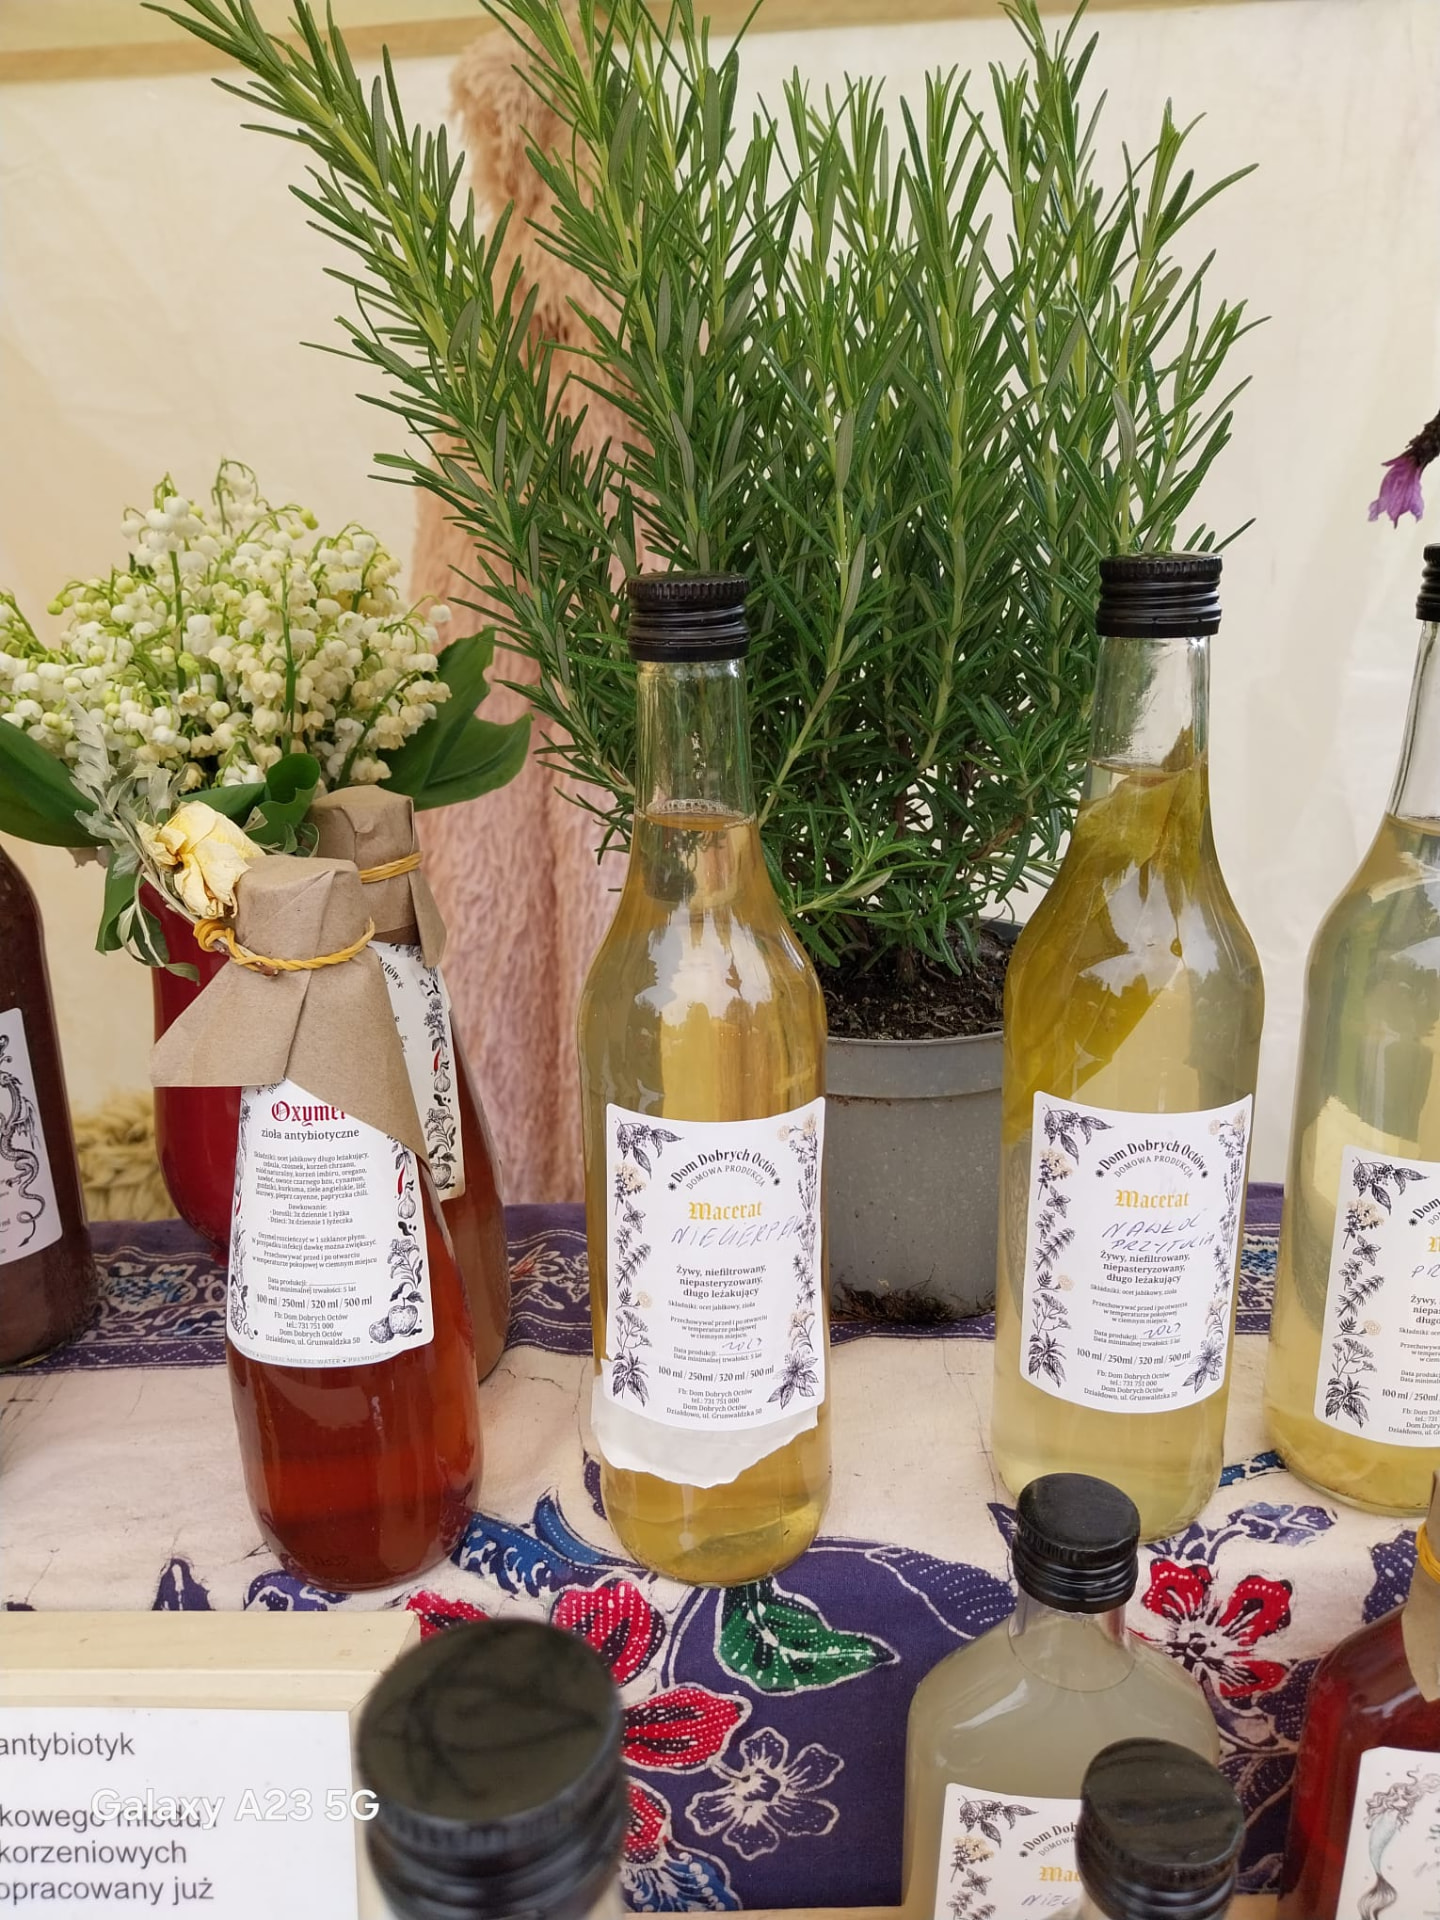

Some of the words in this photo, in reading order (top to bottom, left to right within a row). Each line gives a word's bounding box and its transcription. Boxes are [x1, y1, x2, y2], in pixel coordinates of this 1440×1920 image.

[261, 1128, 282, 1139] zioła
[285, 1129, 360, 1143] antybiotyczne
[1099, 1149, 1127, 1170] Dom
[1127, 1138, 1180, 1156] Dobrych
[1181, 1143, 1206, 1171] Octów
[671, 1159, 699, 1183] Dom
[697, 1148, 750, 1166] Dobrych
[752, 1152, 779, 1179] Octów
[1114, 1156, 1152, 1178] DOMOWA
[1154, 1155, 1194, 1178] PRODUKCJA
[686, 1165, 722, 1190] DOMOWA
[725, 1164, 766, 1187] PRODUKCJA
[1115, 1189, 1189, 1208] Macerat
[688, 1201, 763, 1220] Macerat
[1100, 1249, 1127, 1263] Żywy,
[676, 1263, 703, 1278] Żywy,
[1106, 1273, 1133, 1285] długo
[1134, 1275, 1182, 1285] leżakujący
[257, 1293, 268, 1303] 100
[269, 1296, 278, 1306] ml
[282, 1299, 305, 1308] 250ml
[328, 1299, 338, 1308] ml
[344, 1298, 360, 1307] 500
[361, 1295, 373, 1305] ml
[683, 1288, 710, 1300] długo
[711, 1288, 760, 1299] leżakujący
[284, 1312, 299, 1321] Dom
[300, 1313, 326, 1323] Dobrych
[280, 1328, 294, 1337] Dom
[295, 1330, 321, 1340] Dobrych
[1077, 1347, 1090, 1358] 100
[1091, 1352, 1102, 1361] ml
[1108, 1354, 1133, 1365] 250ml
[1154, 1355, 1164, 1365] ml
[1168, 1352, 1182, 1362] 500
[1183, 1349, 1192, 1360] ml
[658, 1365, 671, 1376] 100
[672, 1368, 683, 1379] ml
[688, 1371, 714, 1382] 250ml
[735, 1371, 745, 1381] ml
[750, 1369, 764, 1379] 500
[765, 1364, 775, 1375] ml
[1382, 1388, 1396, 1398] 100
[1397, 1391, 1408, 1400] ml
[1414, 1393, 1439, 1401] 250ml
[0, 1732, 135, 1761] antybiotyk
[1022, 1831, 1052, 1851] Dom
[172, 1876, 214, 1906] już
